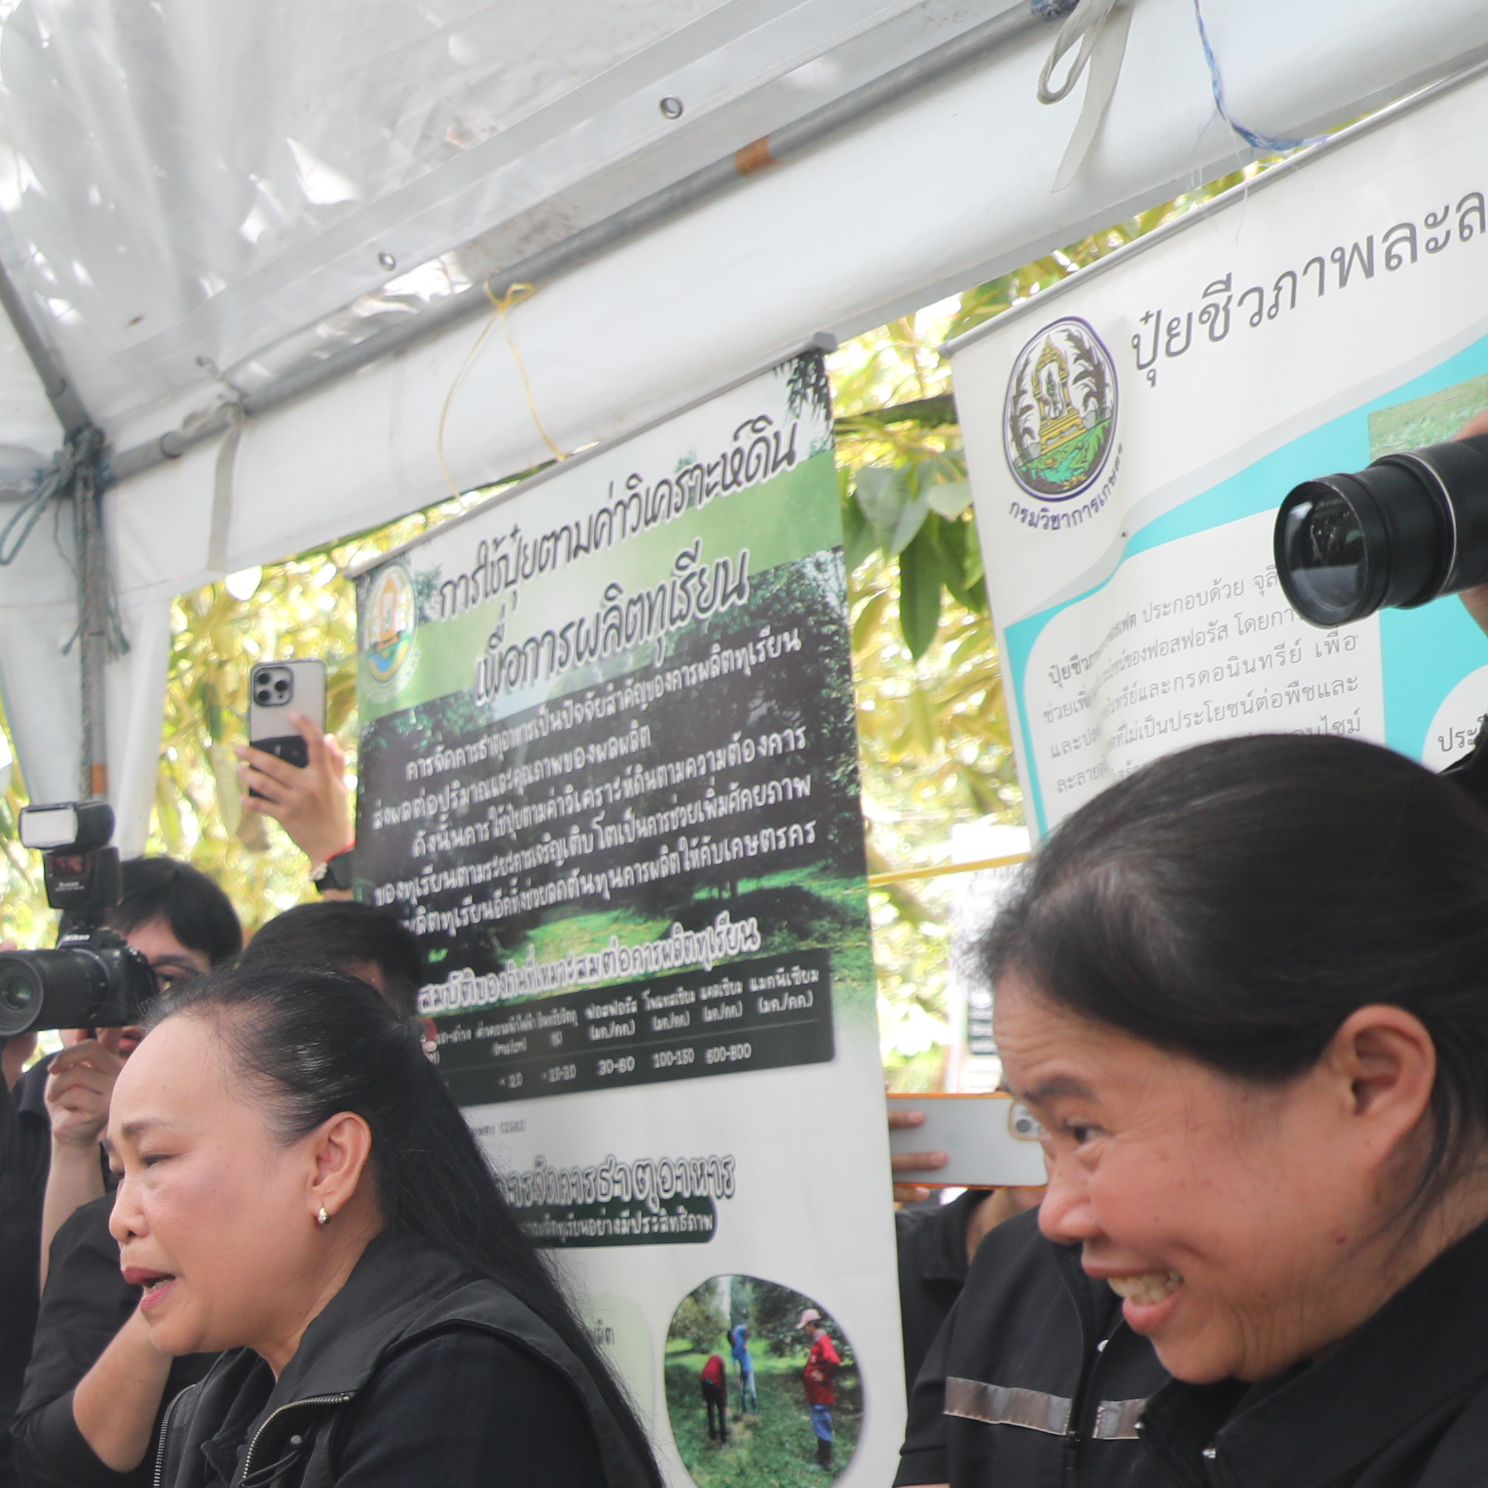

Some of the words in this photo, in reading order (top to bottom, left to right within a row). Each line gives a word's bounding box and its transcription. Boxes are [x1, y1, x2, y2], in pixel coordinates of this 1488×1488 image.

[438, 413, 800, 621] การใช้ปุ๋ยตามค่าวิเคราะห์ดิน
[1142, 575, 1245, 624] ประกอบด้วย
[475, 538, 751, 704] เพื่อการผลิตทุเรียน
